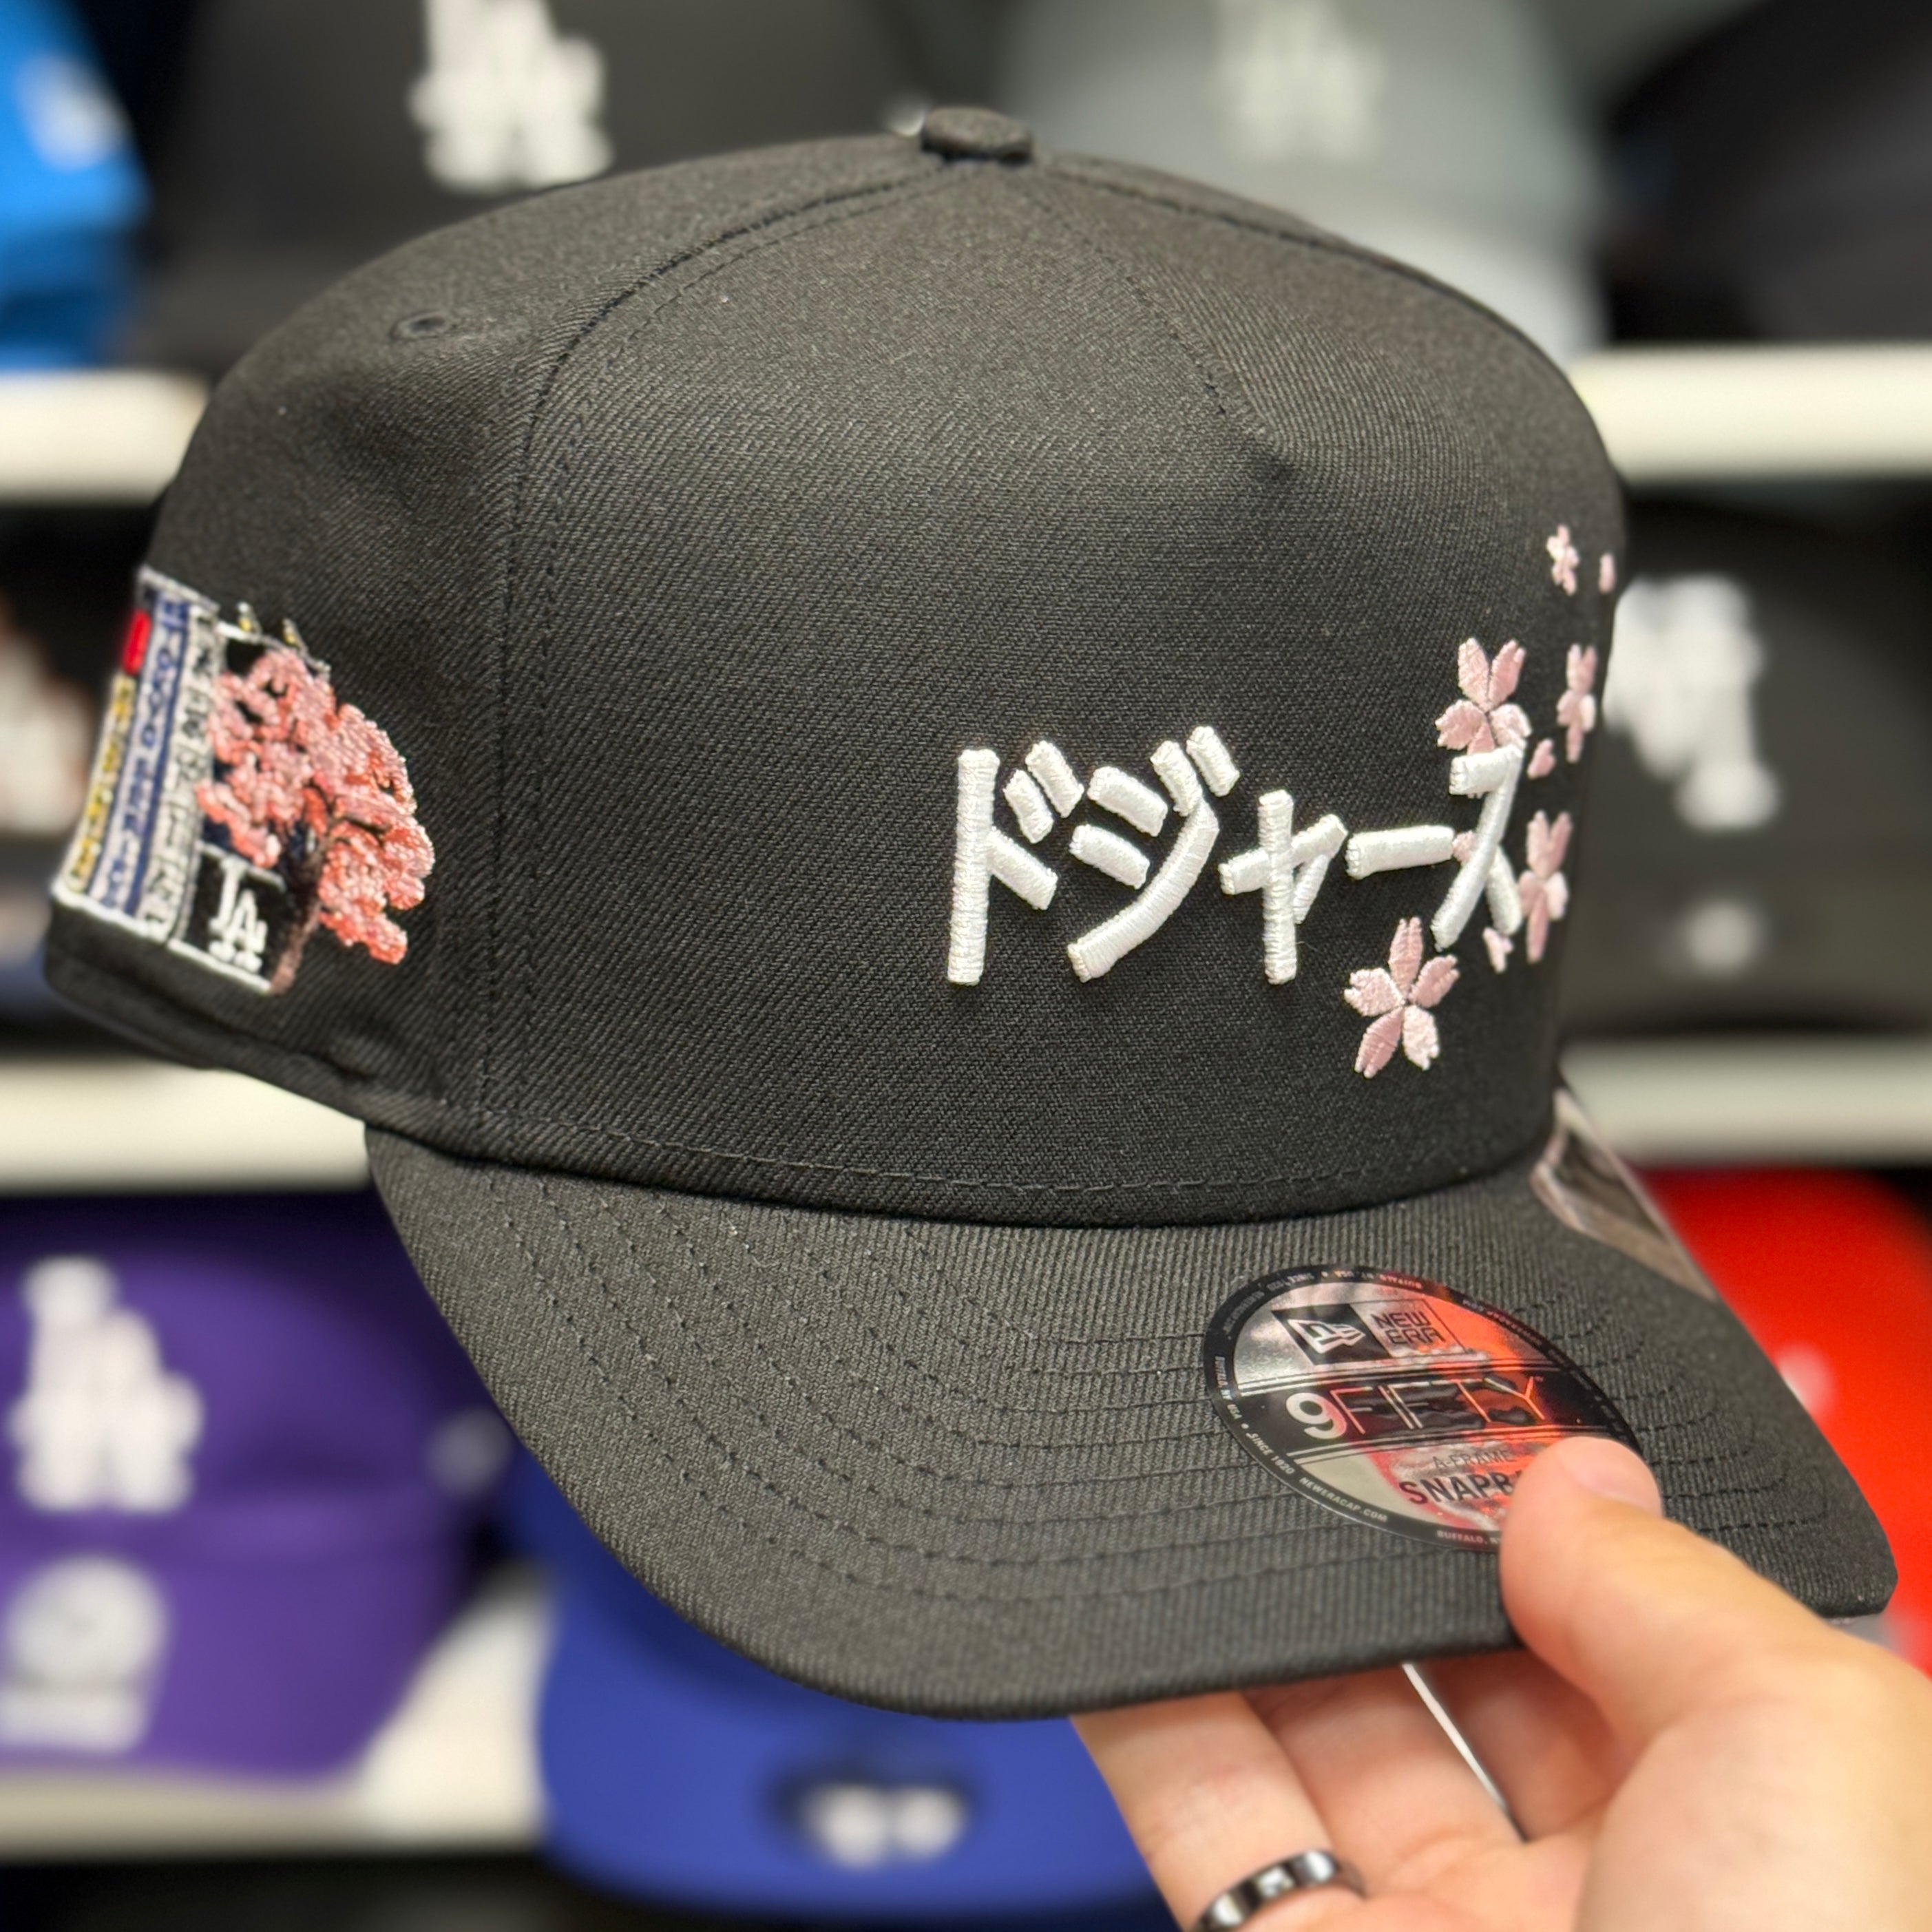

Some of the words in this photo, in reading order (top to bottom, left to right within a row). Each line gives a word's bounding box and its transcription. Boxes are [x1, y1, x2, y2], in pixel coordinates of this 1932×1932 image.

[947, 725, 1526, 986] ドジャース
[207, 857, 268, 972] LA
[1371, 1310, 1431, 1328] NEW
[1385, 1327, 1445, 1345] ERA
[1285, 1376, 1545, 1439] 9FIFTY
[1433, 1448, 1515, 1469] A-FRAME
